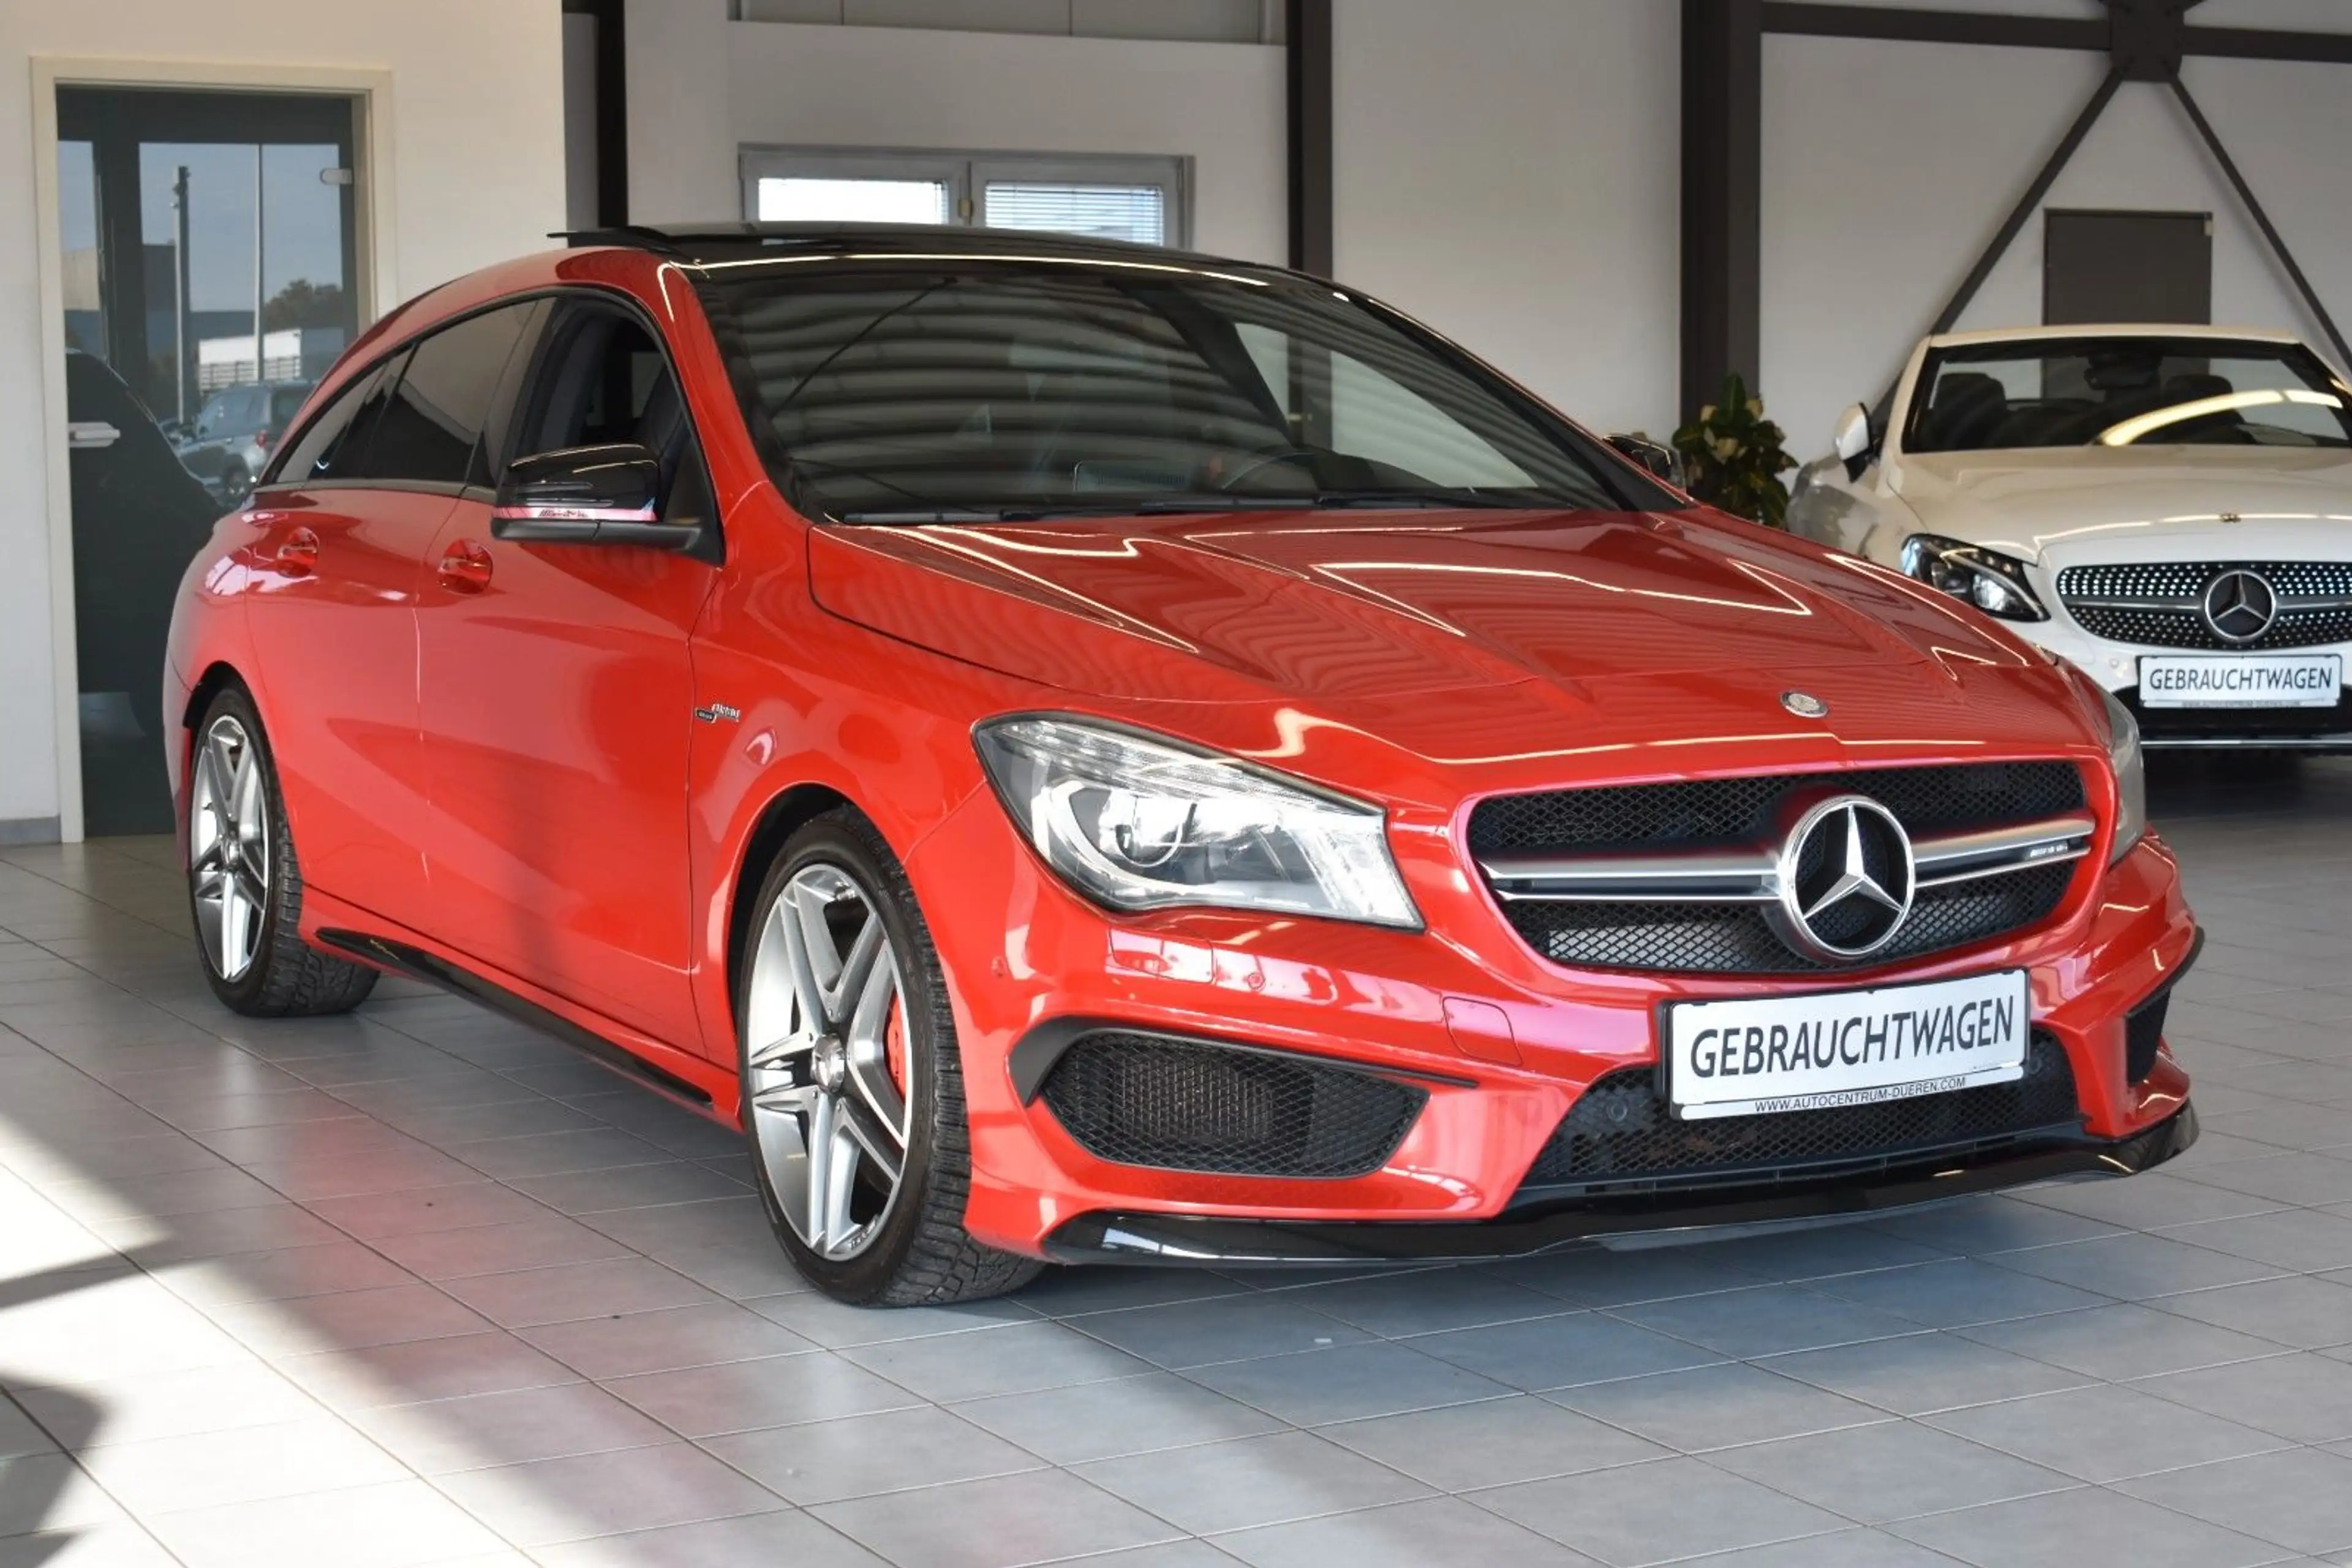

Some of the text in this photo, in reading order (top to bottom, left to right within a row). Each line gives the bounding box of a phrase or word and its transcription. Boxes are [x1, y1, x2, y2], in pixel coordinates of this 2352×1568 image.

[2150, 668, 2332, 690] GEBRAUCHTWAGEN
[1691, 995, 2013, 1078] GEBRAUCHTWAGEN
[1755, 1077, 1966, 1112] WWW.AUTOCENTRUM-DUEREN.COM
